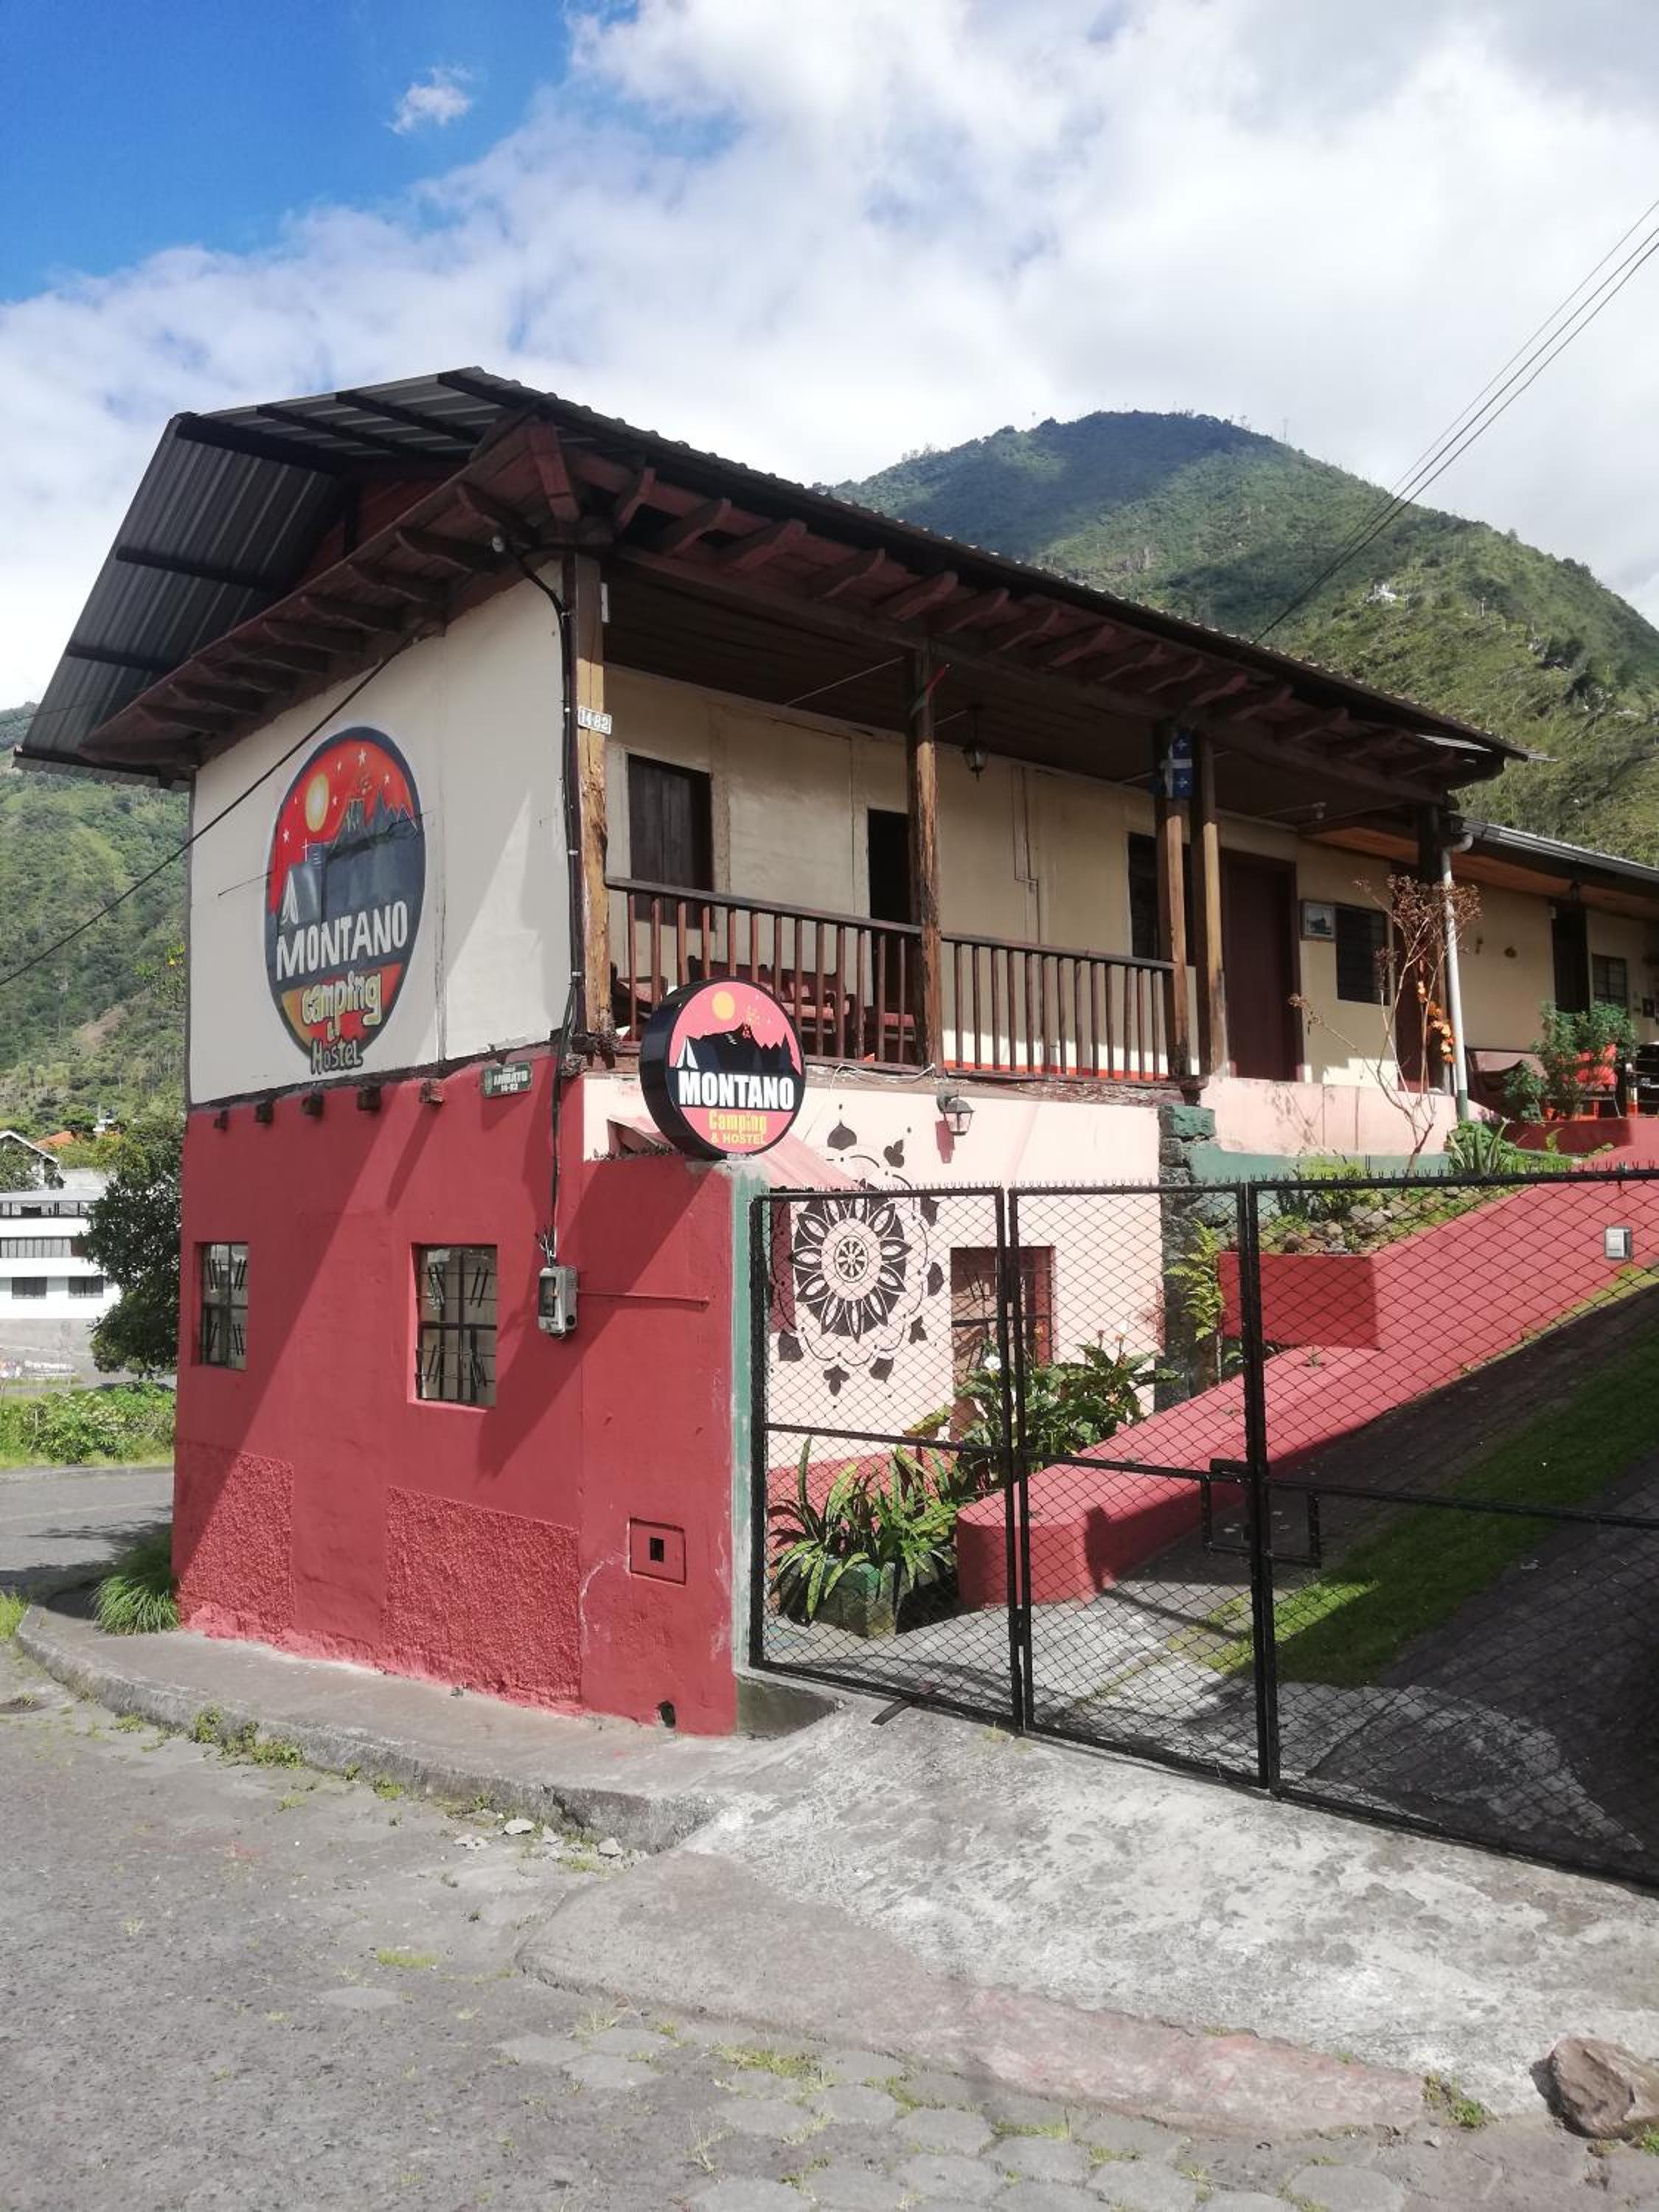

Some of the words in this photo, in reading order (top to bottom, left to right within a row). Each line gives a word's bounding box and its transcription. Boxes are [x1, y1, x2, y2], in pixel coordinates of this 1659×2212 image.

[276, 900, 408, 981] MONTANO
[301, 970, 383, 1036] camping
[678, 1071, 795, 1110] MONTANO
[709, 1109, 768, 1135] Camping
[710, 1132, 719, 1144] &
[723, 1131, 766, 1145] HOSTEL
